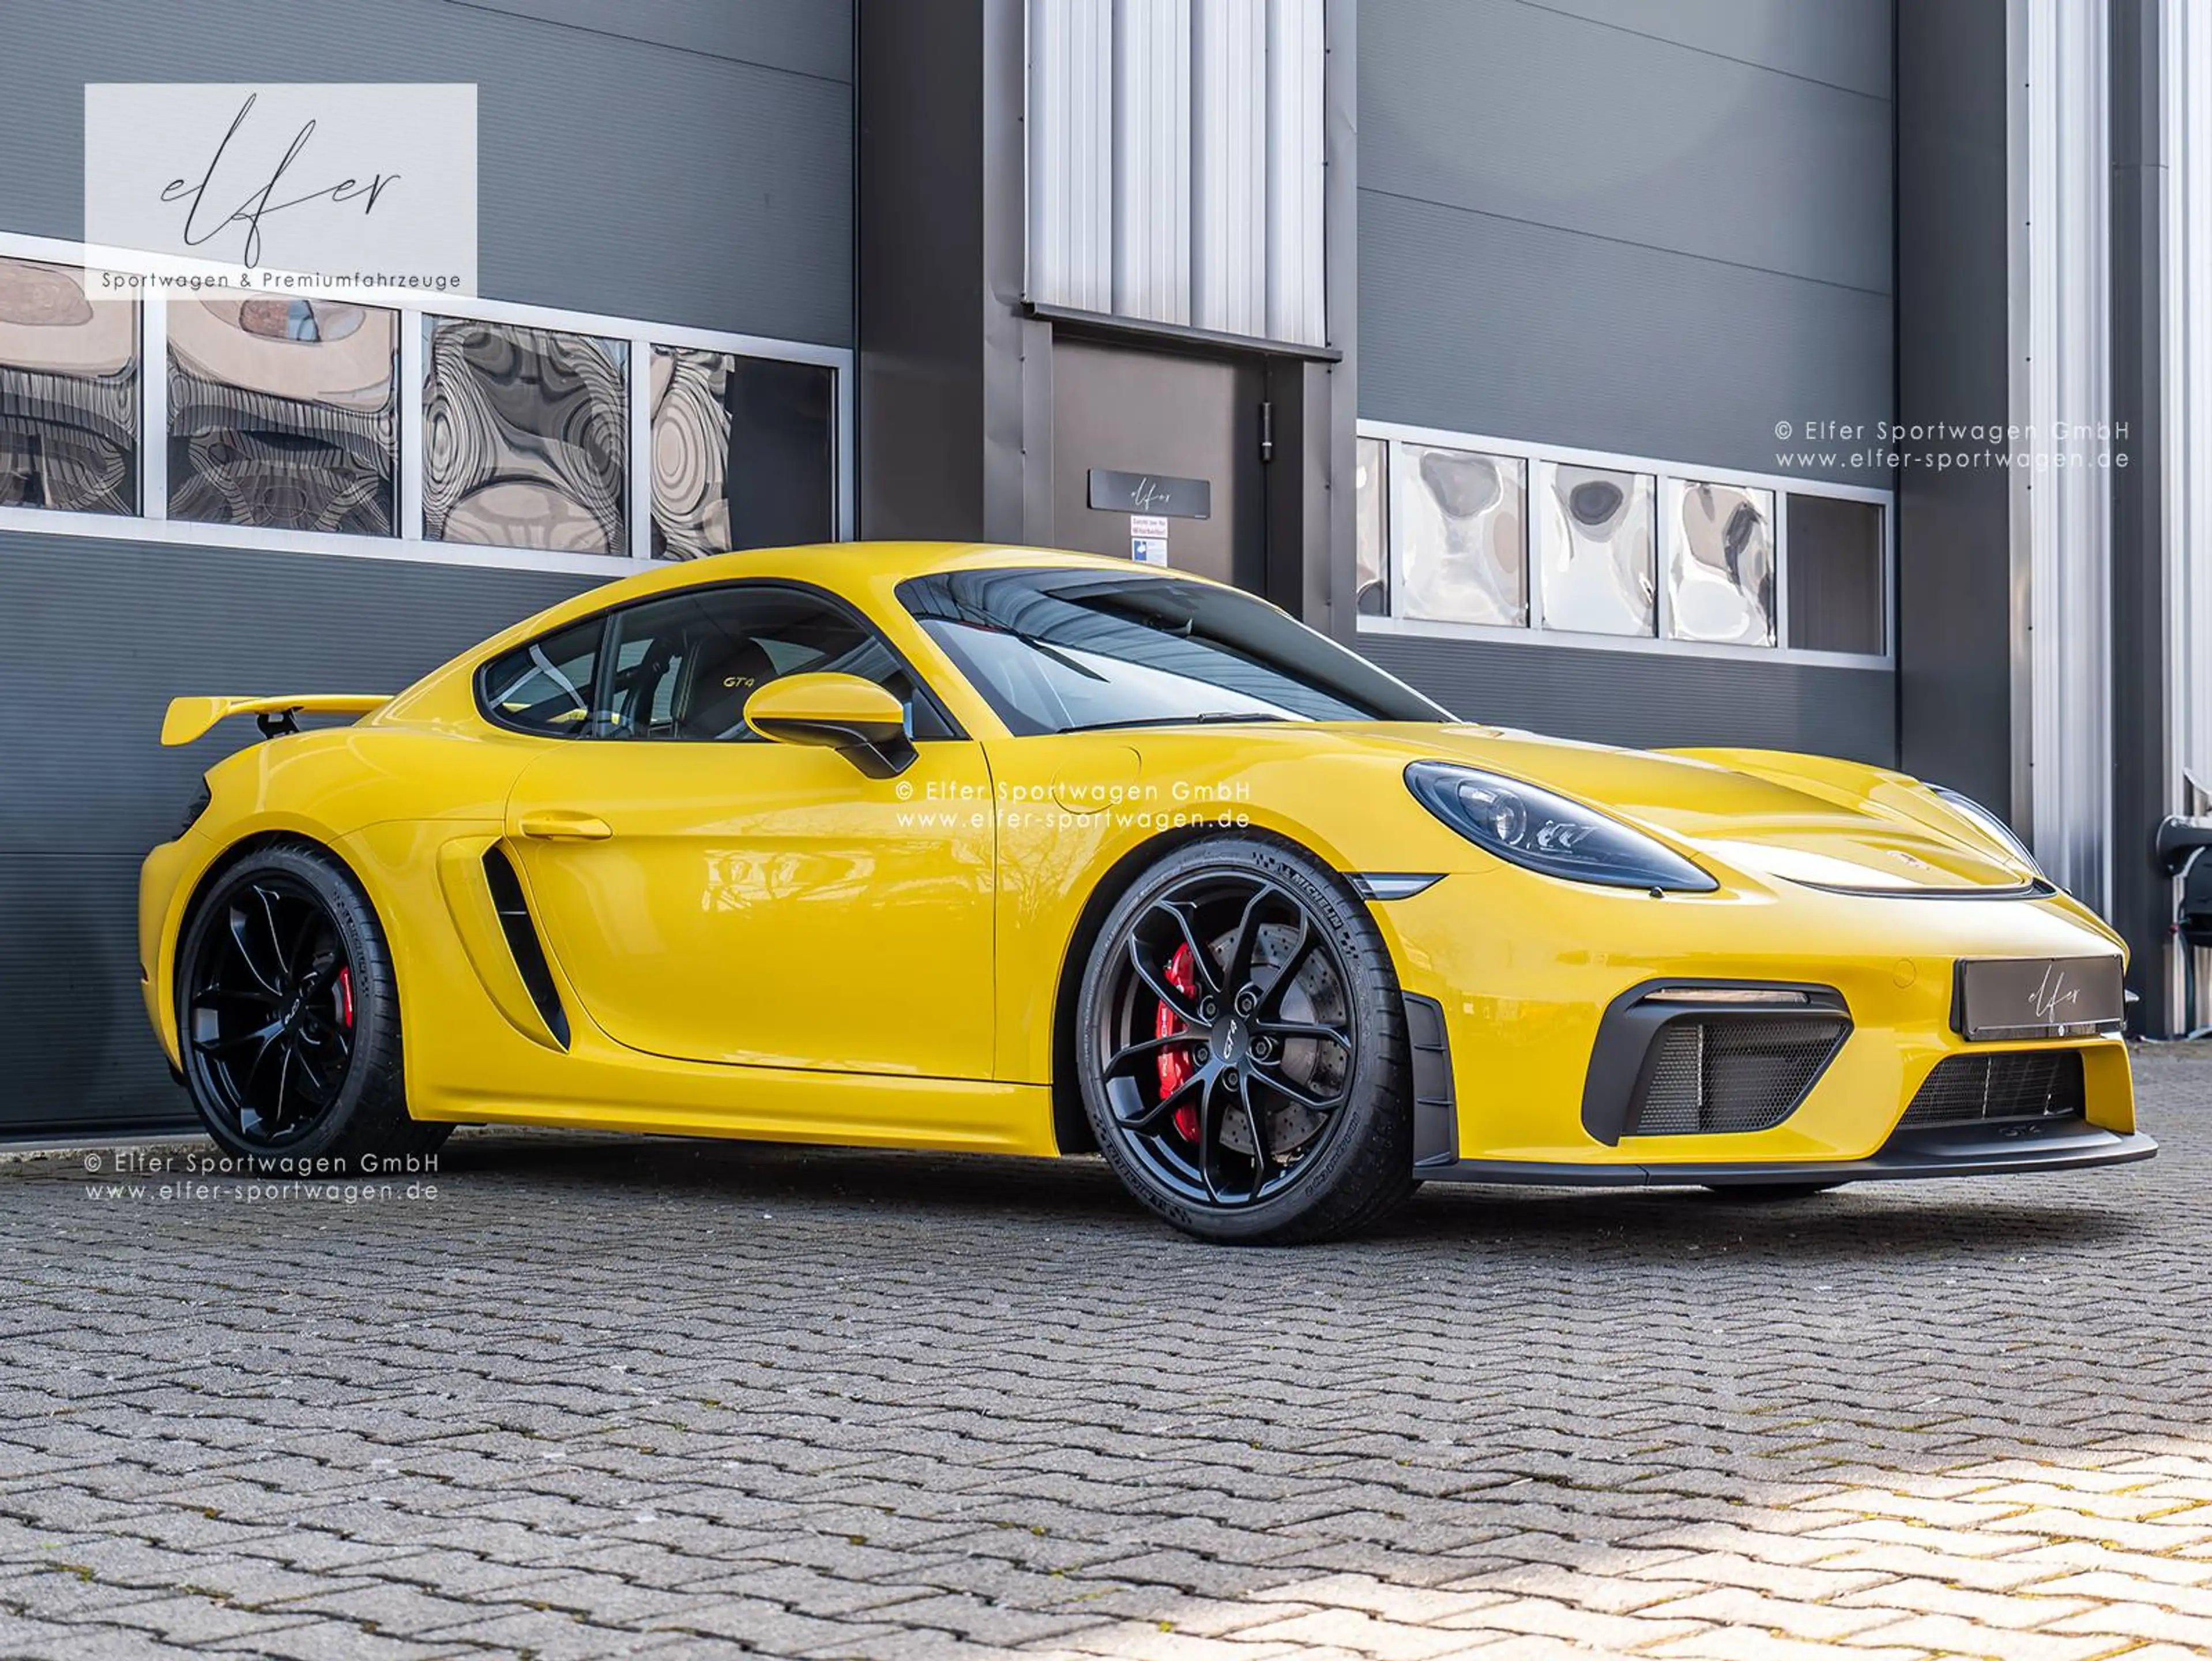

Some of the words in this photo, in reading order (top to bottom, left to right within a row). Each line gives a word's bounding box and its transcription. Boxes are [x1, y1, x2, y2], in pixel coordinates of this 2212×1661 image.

[723, 677, 755, 687] GT4
[1289, 873, 1344, 930] MICHELIN
[1223, 1019, 1237, 1059] GT4
